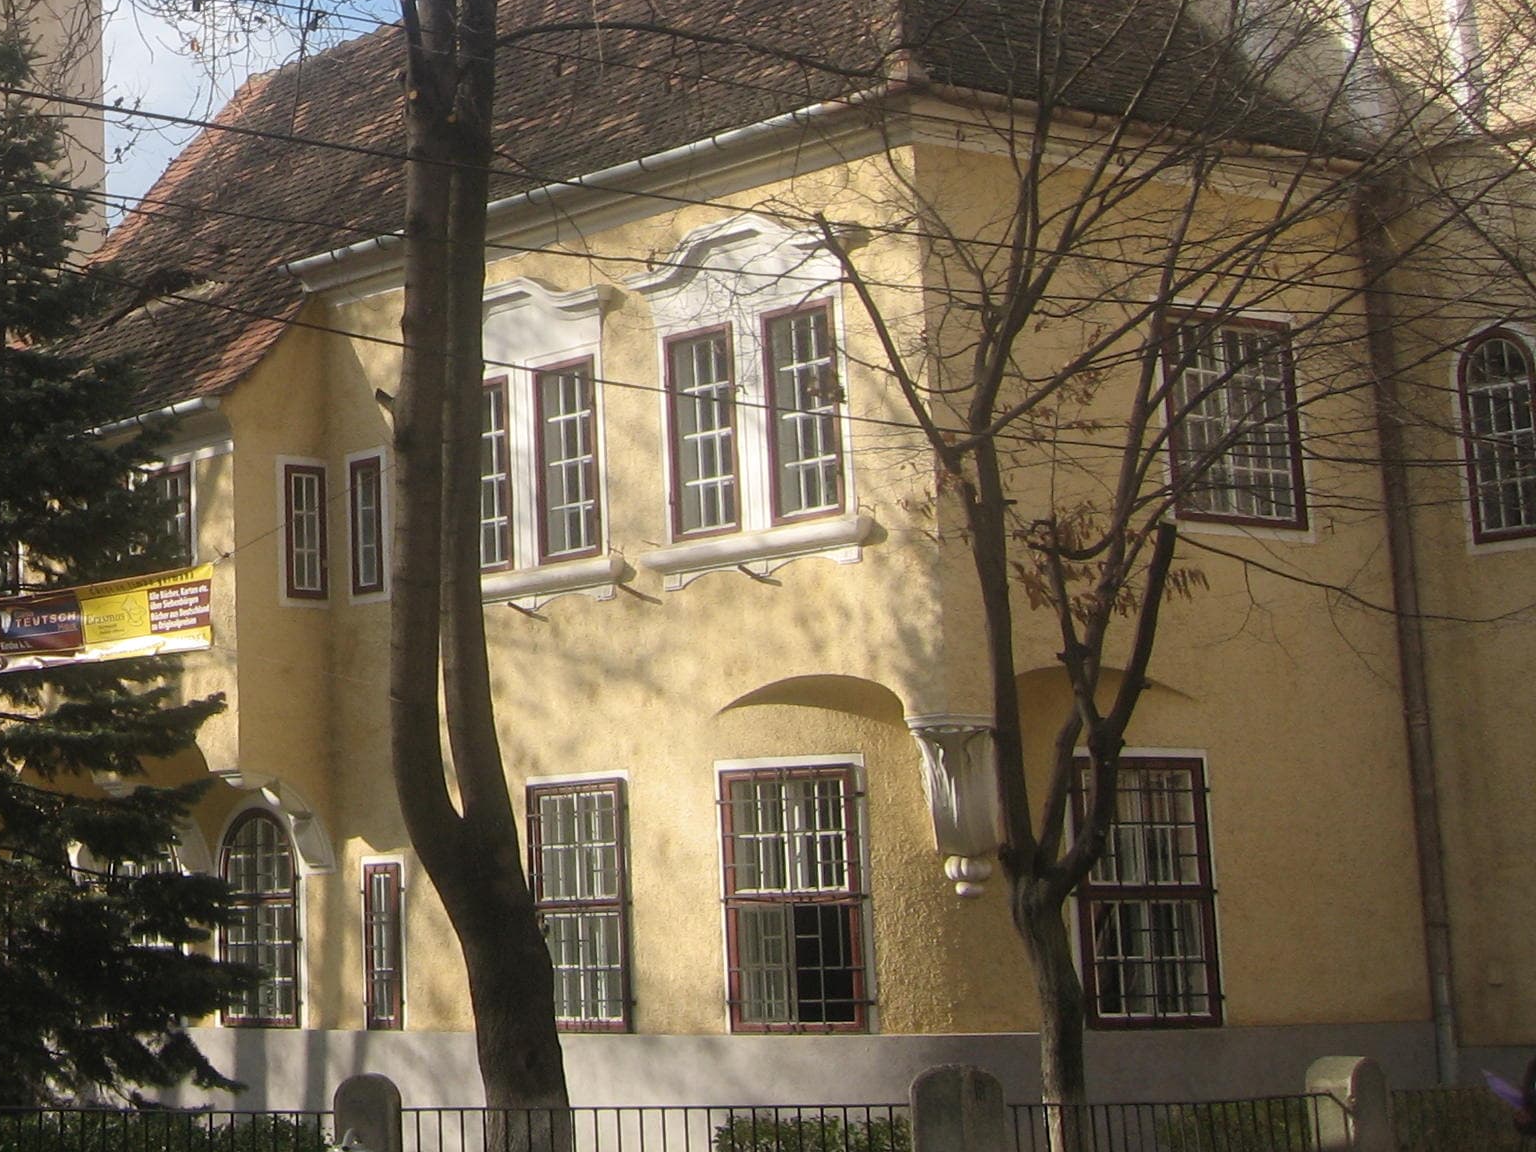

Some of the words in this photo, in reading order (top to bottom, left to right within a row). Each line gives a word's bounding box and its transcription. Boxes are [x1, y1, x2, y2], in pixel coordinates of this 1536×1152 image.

[180, 586, 198, 596] Karten
[15, 611, 76, 628] TEUTSCH
[85, 613, 125, 625] Erasmus
